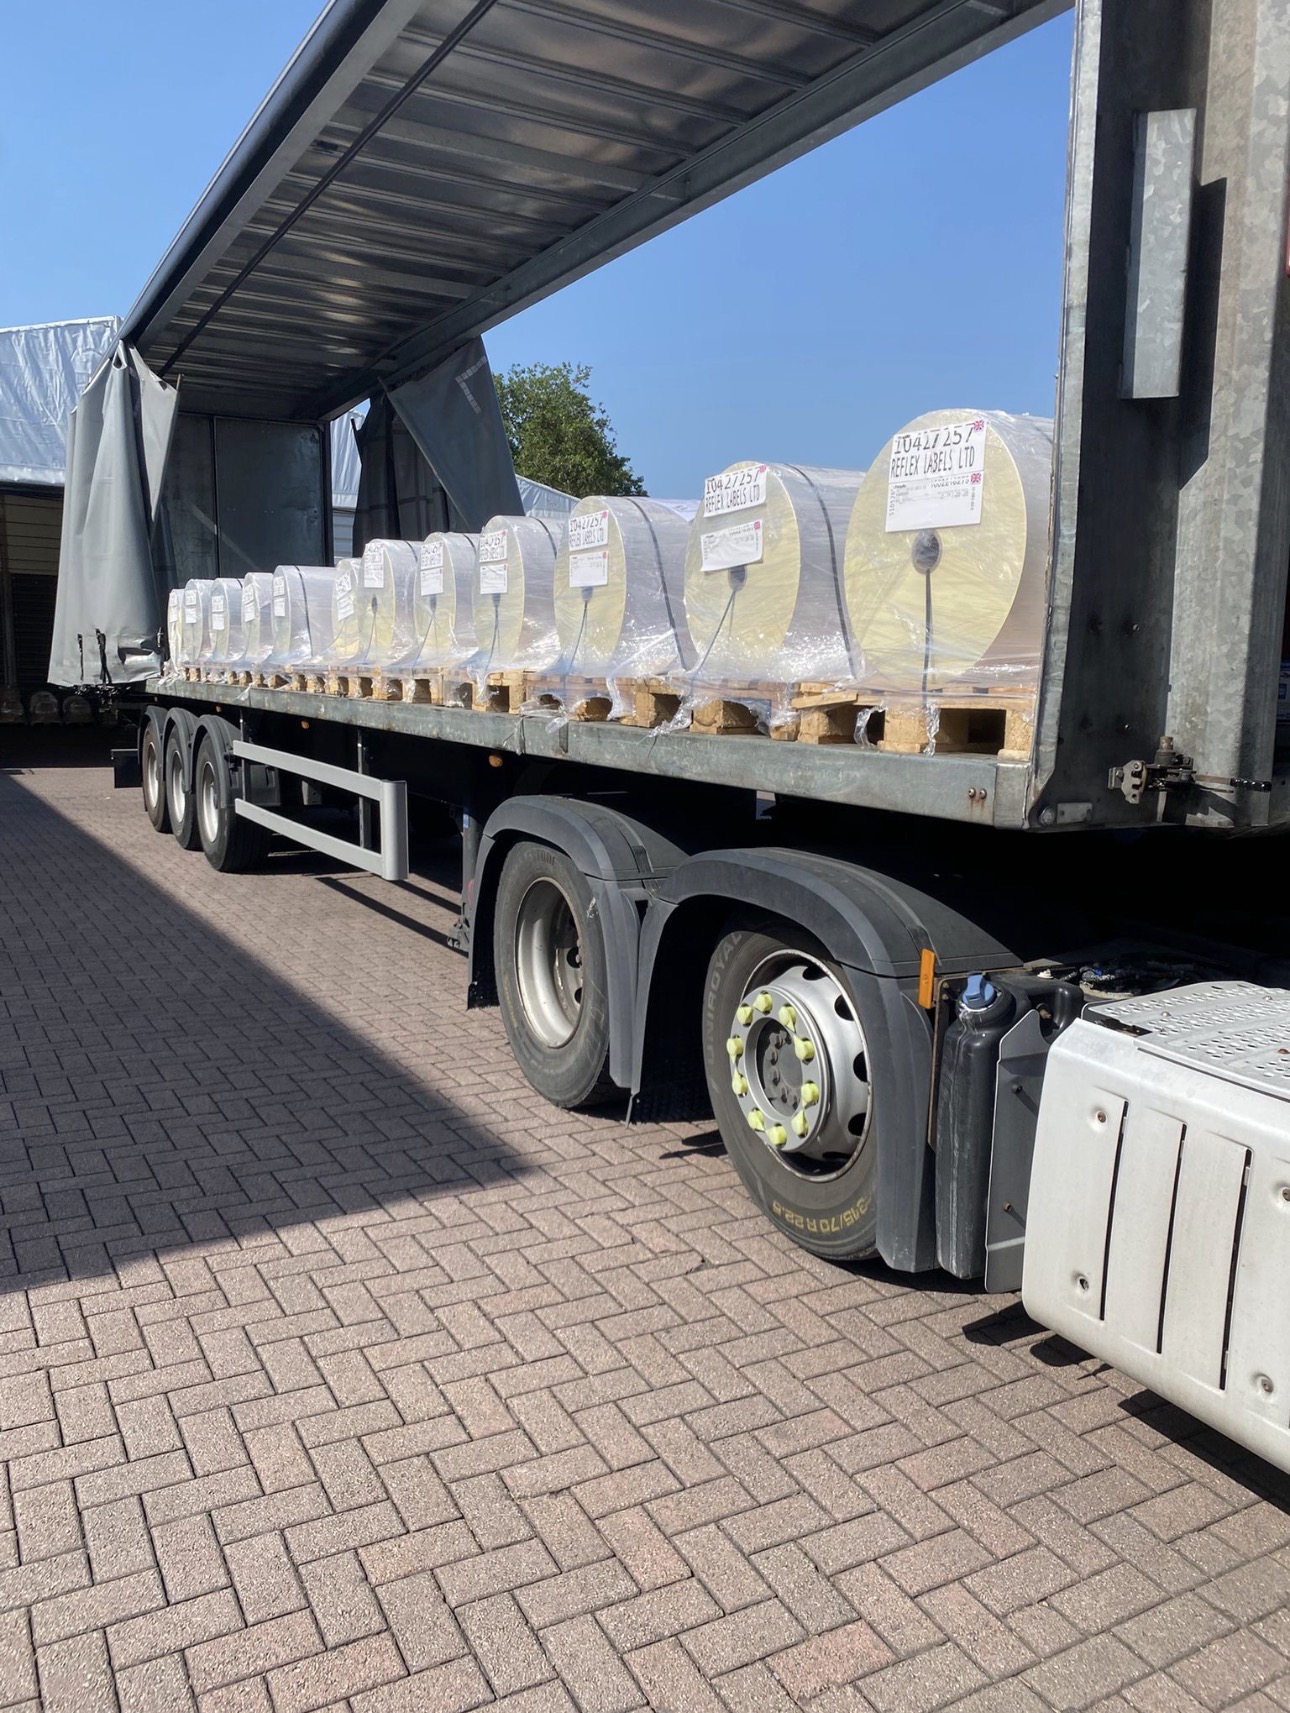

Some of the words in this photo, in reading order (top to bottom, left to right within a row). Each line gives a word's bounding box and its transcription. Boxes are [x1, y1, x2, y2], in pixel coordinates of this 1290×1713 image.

[891, 455, 920, 477] REFLEX
[924, 449, 953, 473] LABELS
[958, 446, 975, 468] LTD
[726, 487, 747, 508] LABELS
[706, 932, 742, 1065] UNIROYAL
